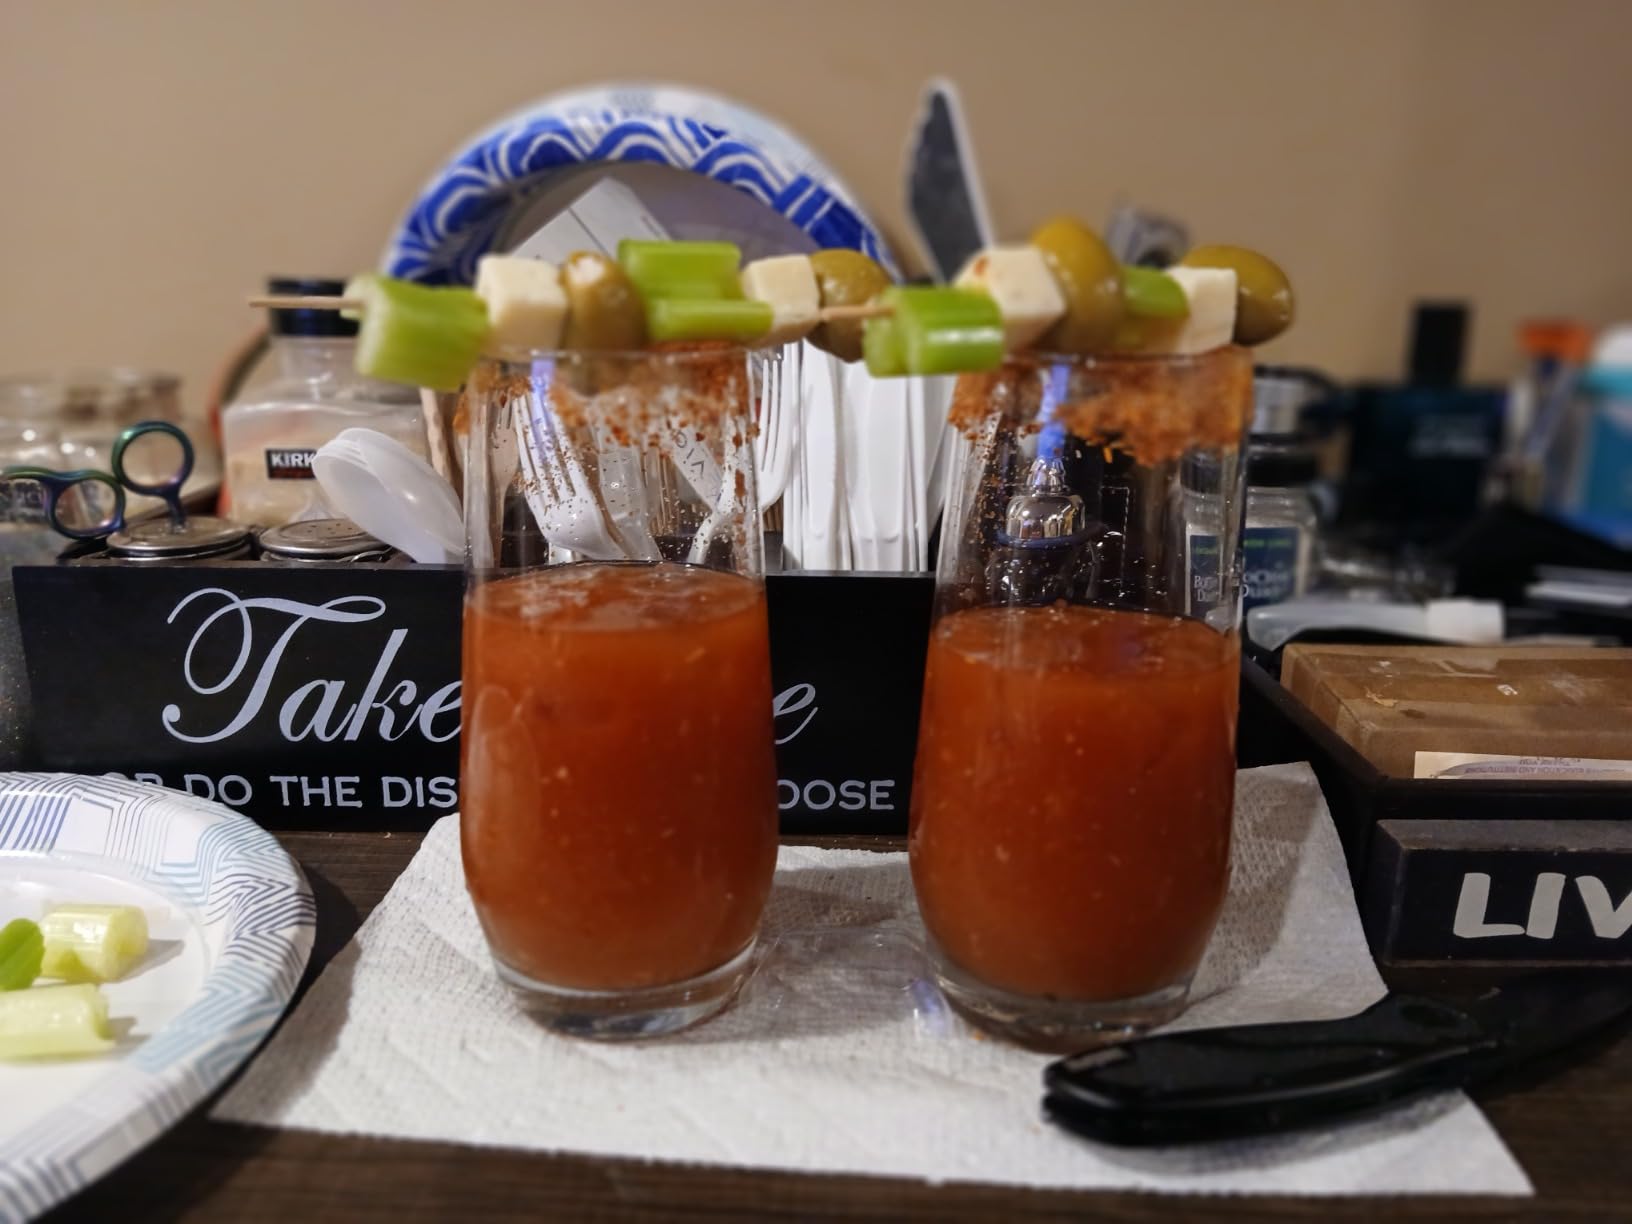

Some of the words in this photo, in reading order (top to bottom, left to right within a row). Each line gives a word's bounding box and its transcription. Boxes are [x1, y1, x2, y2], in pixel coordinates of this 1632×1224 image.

[271, 452, 316, 467] KIRK
[162, 587, 463, 743] Take
[184, 773, 253, 806] DO
[269, 775, 363, 809] THE
[381, 776, 458, 808] DIS
[1453, 872, 1632, 940] LIV
